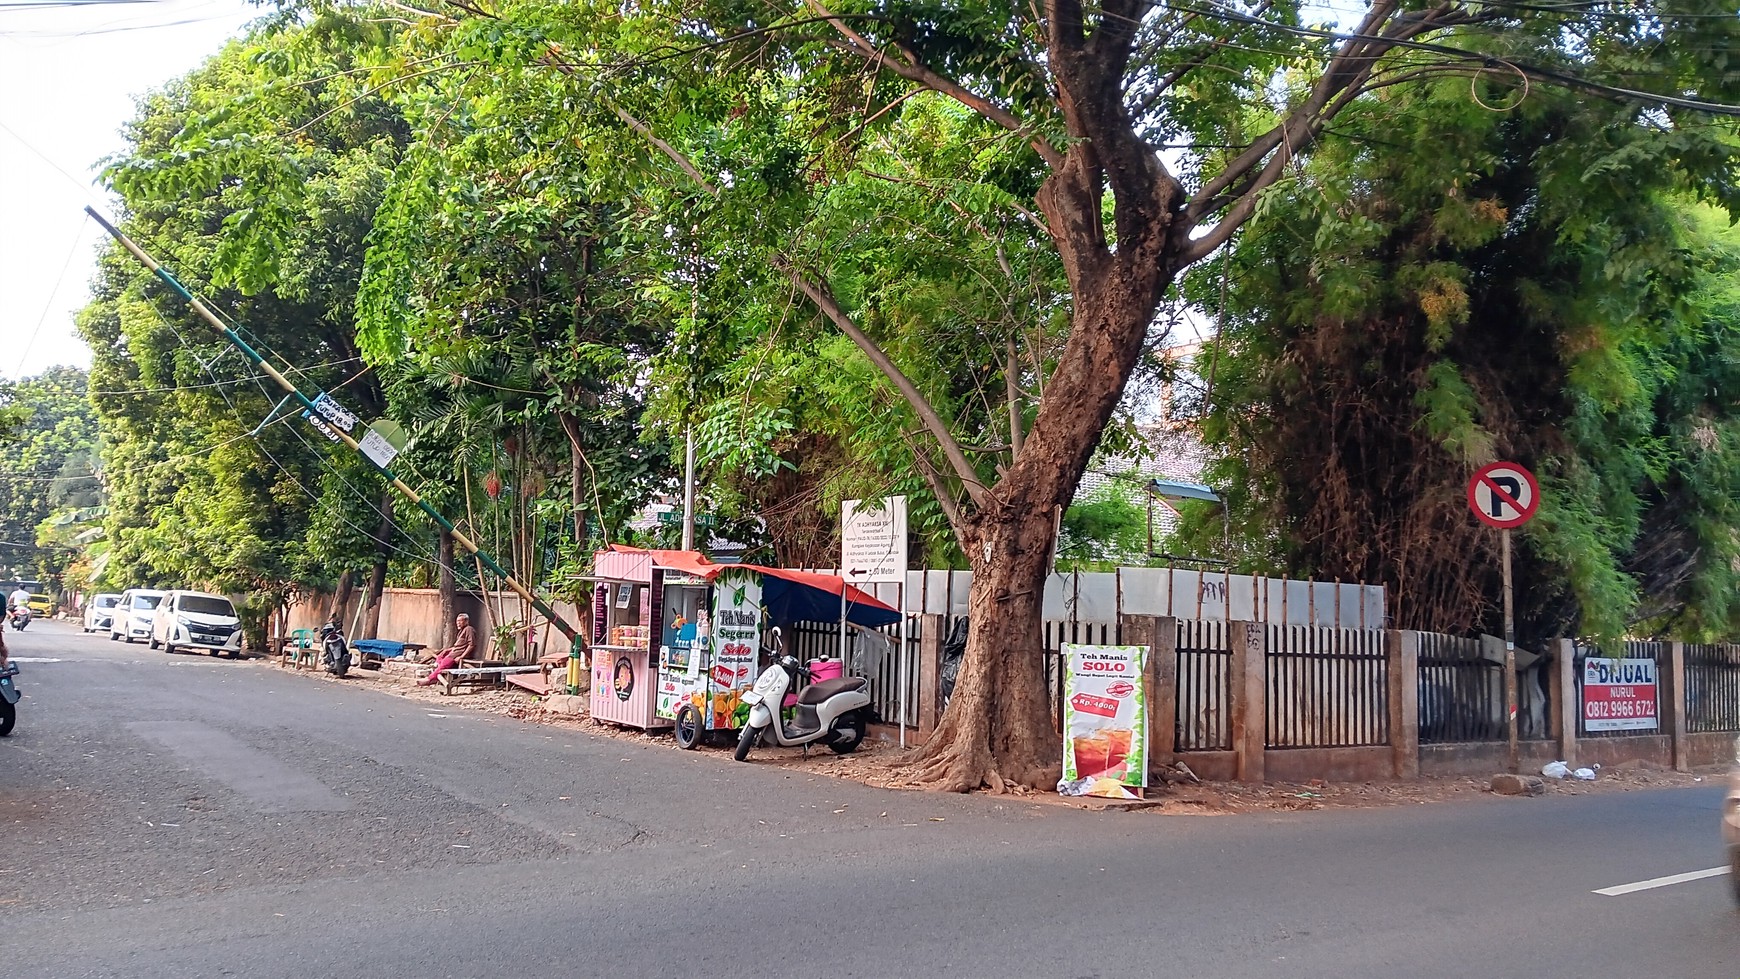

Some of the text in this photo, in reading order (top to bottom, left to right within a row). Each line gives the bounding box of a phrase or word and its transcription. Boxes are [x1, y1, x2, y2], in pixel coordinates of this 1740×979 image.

[316, 403, 336, 419] TUTUP
[323, 396, 341, 412] BUKA
[1082, 662, 1125, 672] SOLO
[1599, 664, 1652, 683] DIJUAL
[1610, 687, 1636, 698] NURUL
[1586, 701, 1608, 717] 0812
[1611, 701, 1634, 717] 9966
